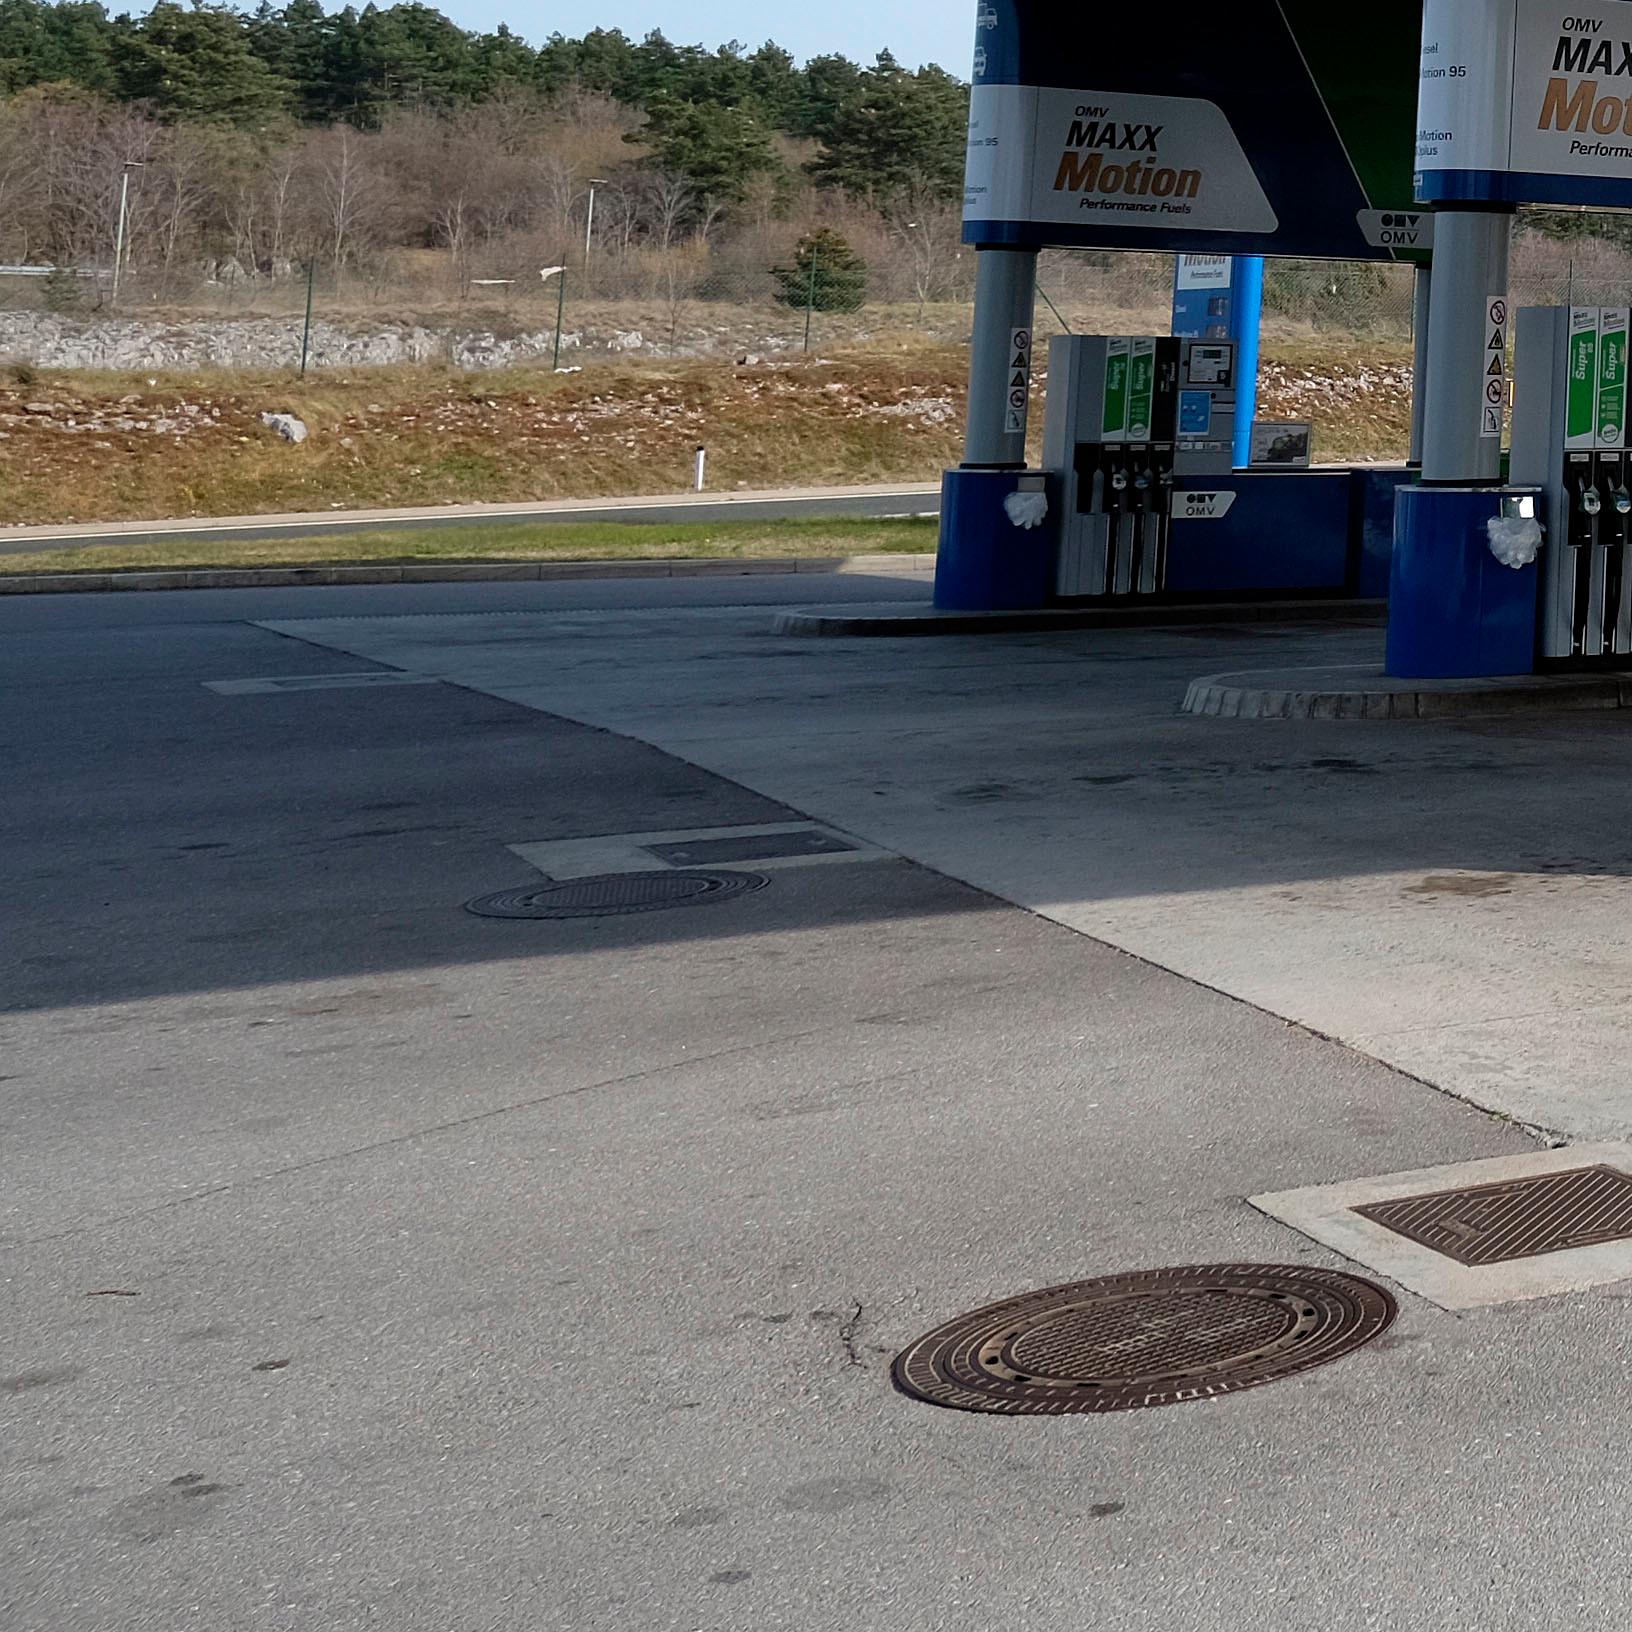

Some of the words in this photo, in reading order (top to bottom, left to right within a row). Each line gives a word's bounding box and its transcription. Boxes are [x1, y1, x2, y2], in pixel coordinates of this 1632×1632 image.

[1562, 16, 1603, 33] OMV
[1449, 65, 1466, 78] 95
[1075, 105, 1110, 118] OMV
[1065, 120, 1164, 152] MAXX
[1053, 151, 1202, 198] Motion
[1080, 198, 1157, 212] Performance
[1160, 202, 1192, 214] Fuels
[1380, 231, 1418, 244] OMV
[1575, 339, 1588, 380] Super
[1605, 341, 1618, 380] Super
[1186, 506, 1215, 516] OMV
